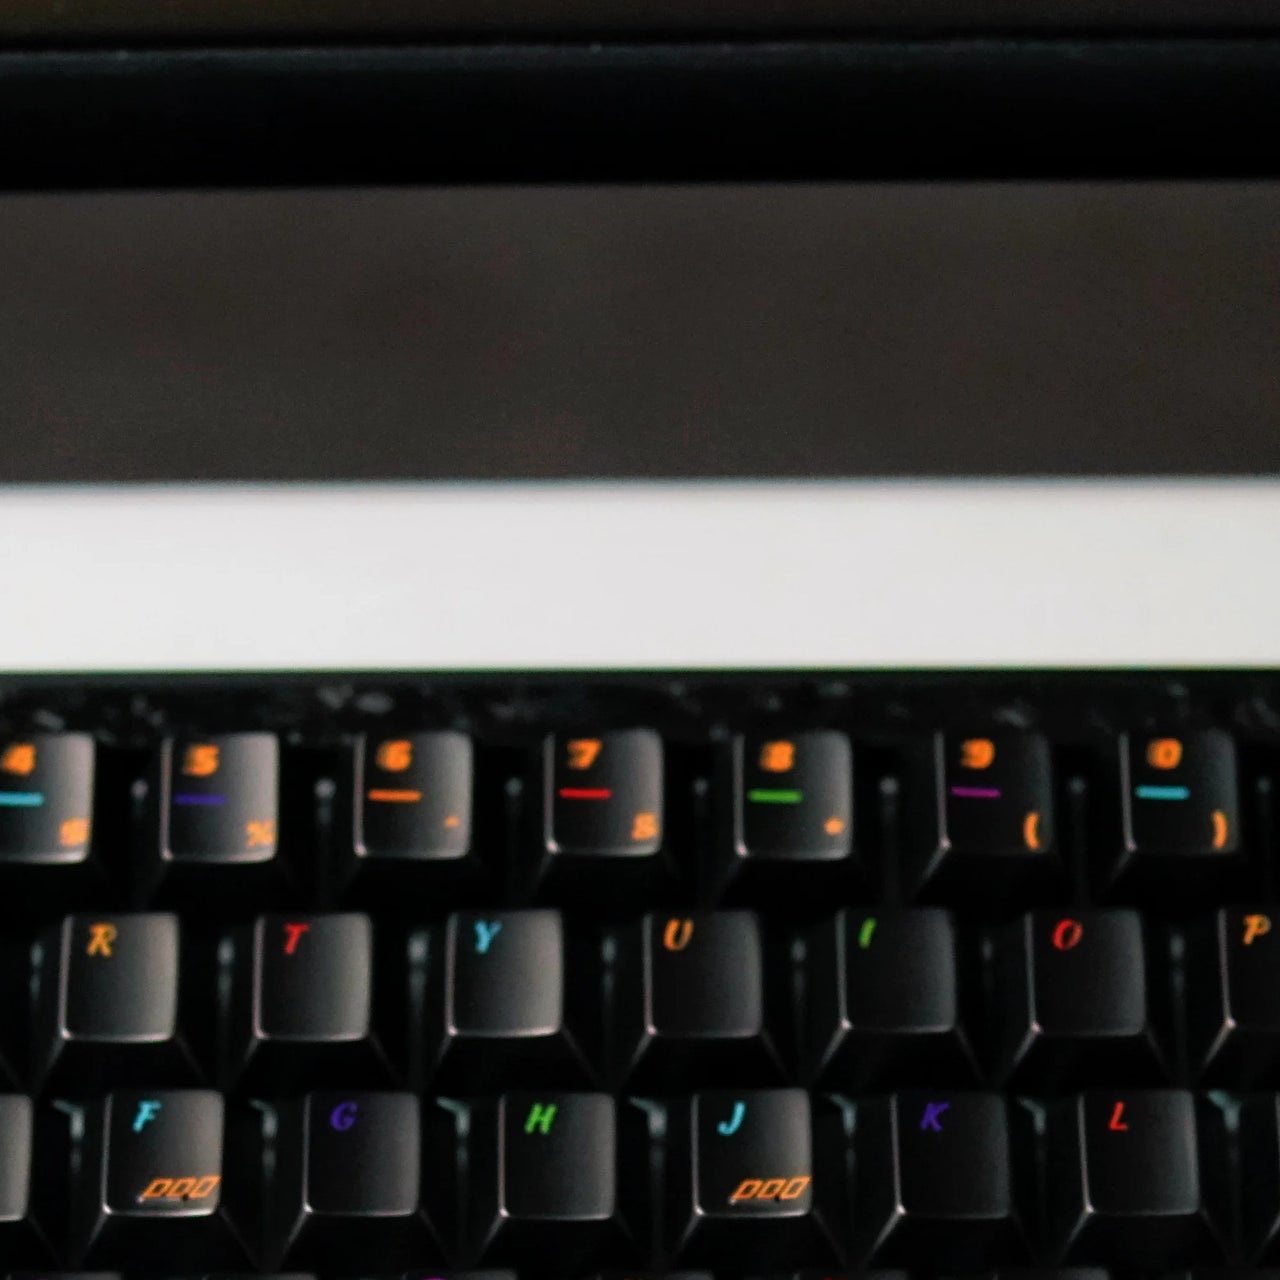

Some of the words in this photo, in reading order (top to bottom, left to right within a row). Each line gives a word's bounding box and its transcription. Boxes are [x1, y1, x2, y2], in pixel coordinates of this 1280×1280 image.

[3, 744, 35, 775] 4
[189, 745, 218, 776] 5
[380, 740, 412, 771] 6
[571, 739, 601, 769] 7
[764, 741, 794, 772] 8
[965, 739, 994, 769] 9
[1151, 739, 1181, 769] 0
[88, 923, 114, 956] R
[285, 923, 308, 954] T
[474, 920, 500, 953] Y
[663, 919, 692, 950] U
[1052, 919, 1082, 950] O
[1243, 914, 1268, 944] P
[133, 1100, 161, 1131] F
[330, 1102, 357, 1131] G
[526, 1103, 557, 1133] H
[717, 1101, 747, 1136] J
[920, 1102, 949, 1131] K
[1108, 1101, 1127, 1131] L
